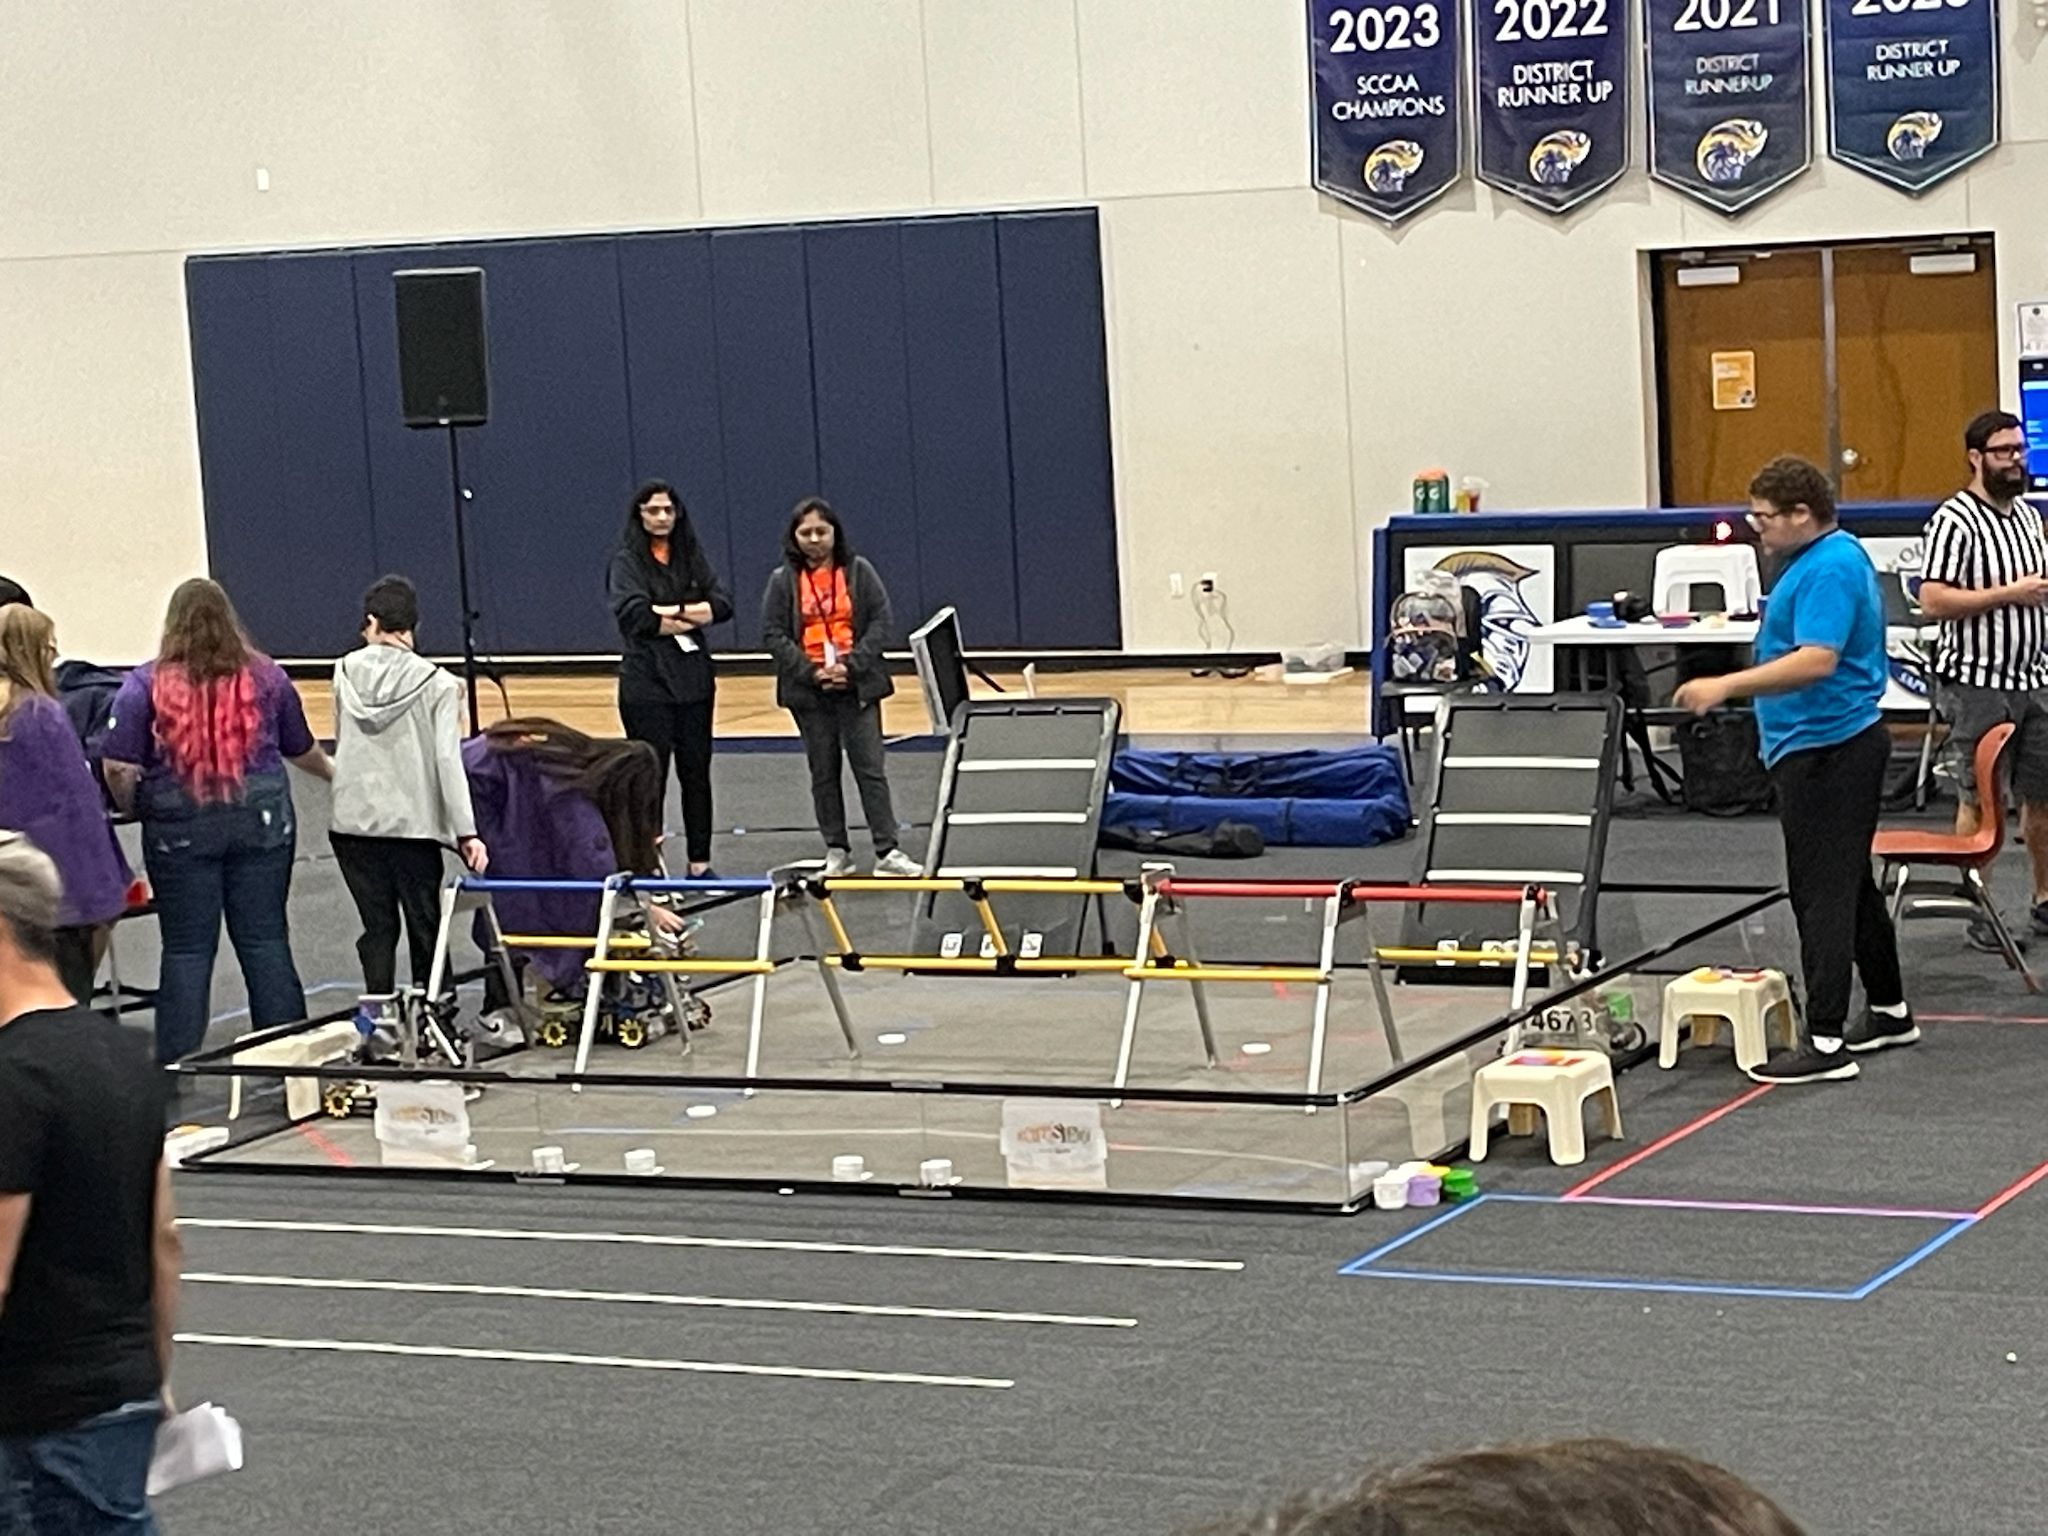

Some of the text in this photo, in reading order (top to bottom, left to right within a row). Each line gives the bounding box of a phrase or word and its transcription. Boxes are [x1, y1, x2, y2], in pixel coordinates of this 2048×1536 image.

[1329, 3, 1441, 53] 2023
[1494, 0, 1609, 42] 2022
[1673, 0, 1780, 32] 2021
[1876, 39, 1949, 61] DISTRICT
[1512, 60, 1595, 85] DISTRICT
[1695, 53, 1760, 74] DISTRICT
[1867, 60, 1961, 82] RUNNER UP
[1356, 74, 1419, 96] SCCAA
[1497, 80, 1614, 109] RUNNER UP
[1684, 73, 1774, 96] RUNNER UP
[1331, 96, 1446, 121] CHAMPIONS
